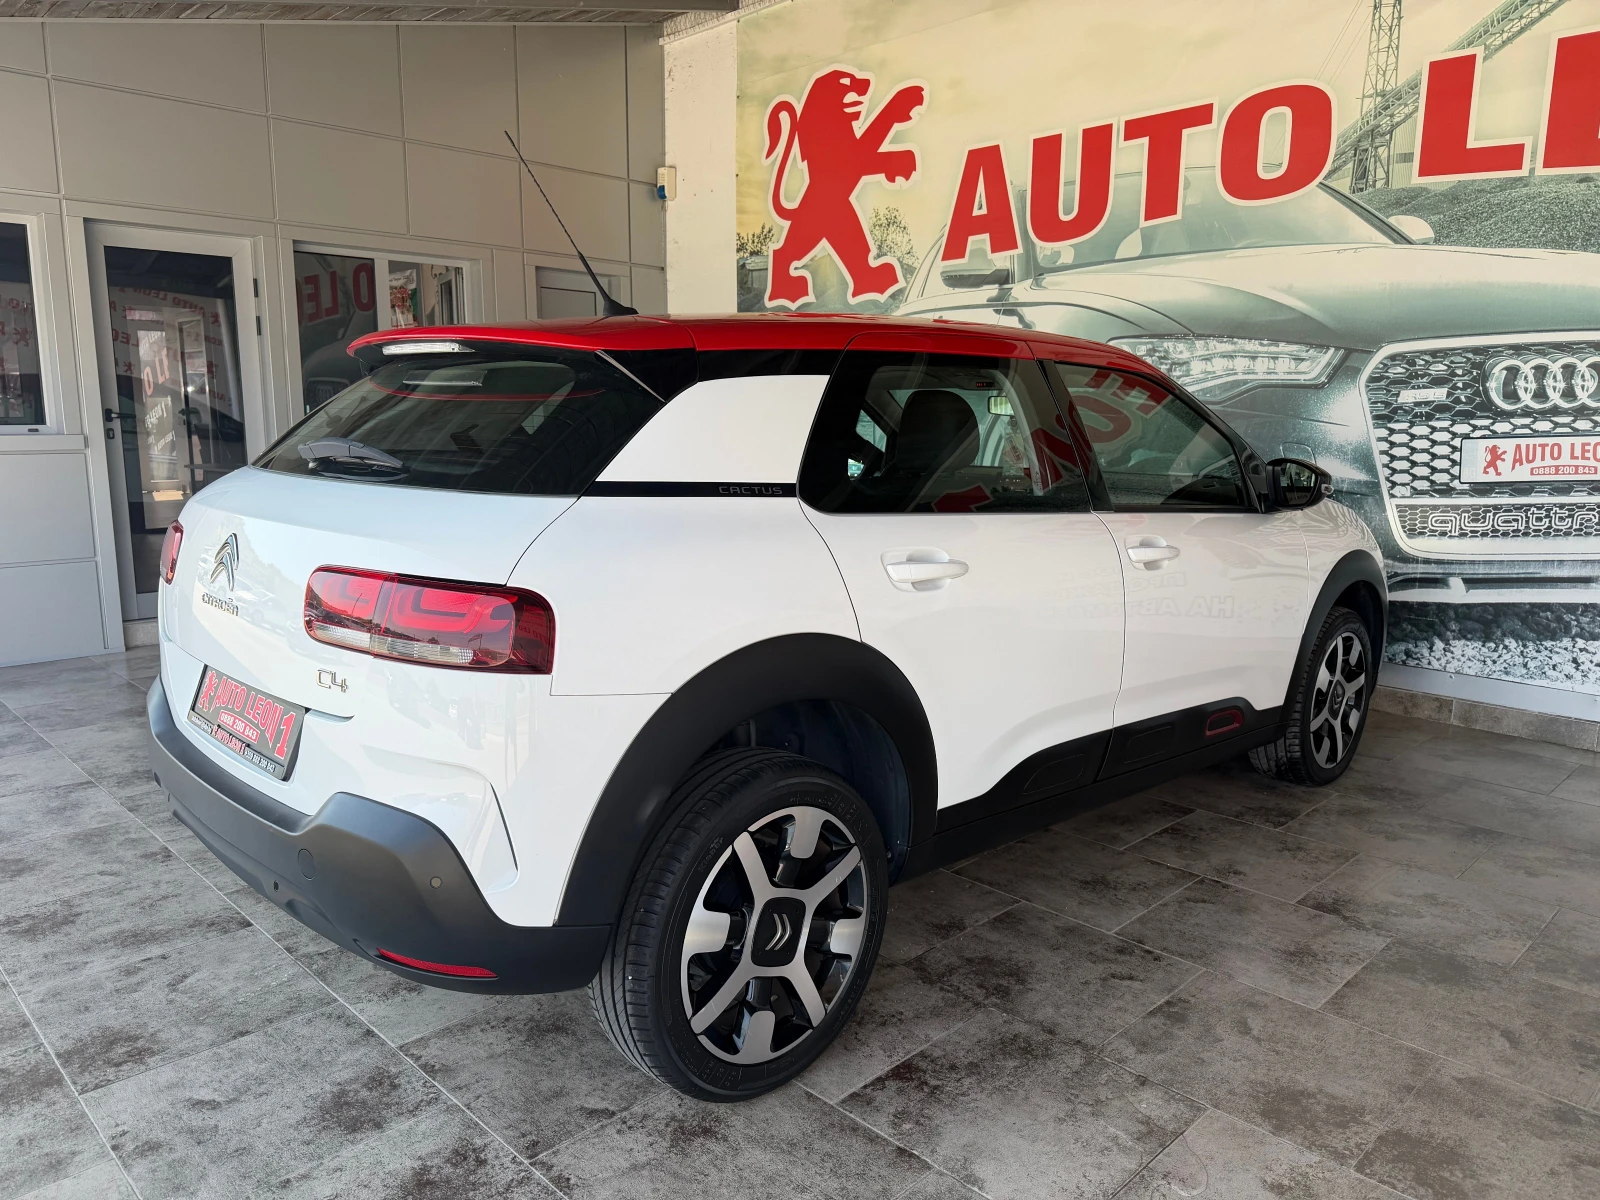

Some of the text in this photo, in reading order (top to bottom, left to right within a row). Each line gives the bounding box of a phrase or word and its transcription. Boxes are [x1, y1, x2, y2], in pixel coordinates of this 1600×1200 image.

[940, 83, 1334, 263] AUTO
[1511, 442, 1562, 472] AUTO
[1533, 466, 1595, 475] 0888 200 843
[718, 485, 783, 495] CACTUS
[316, 668, 349, 693] C4
[210, 676, 247, 713] AUTO
[244, 691, 284, 748] LEON
[274, 711, 296, 759] 1
[220, 712, 235, 726] 0888
[233, 719, 245, 731] 200
[244, 726, 257, 740] 843
